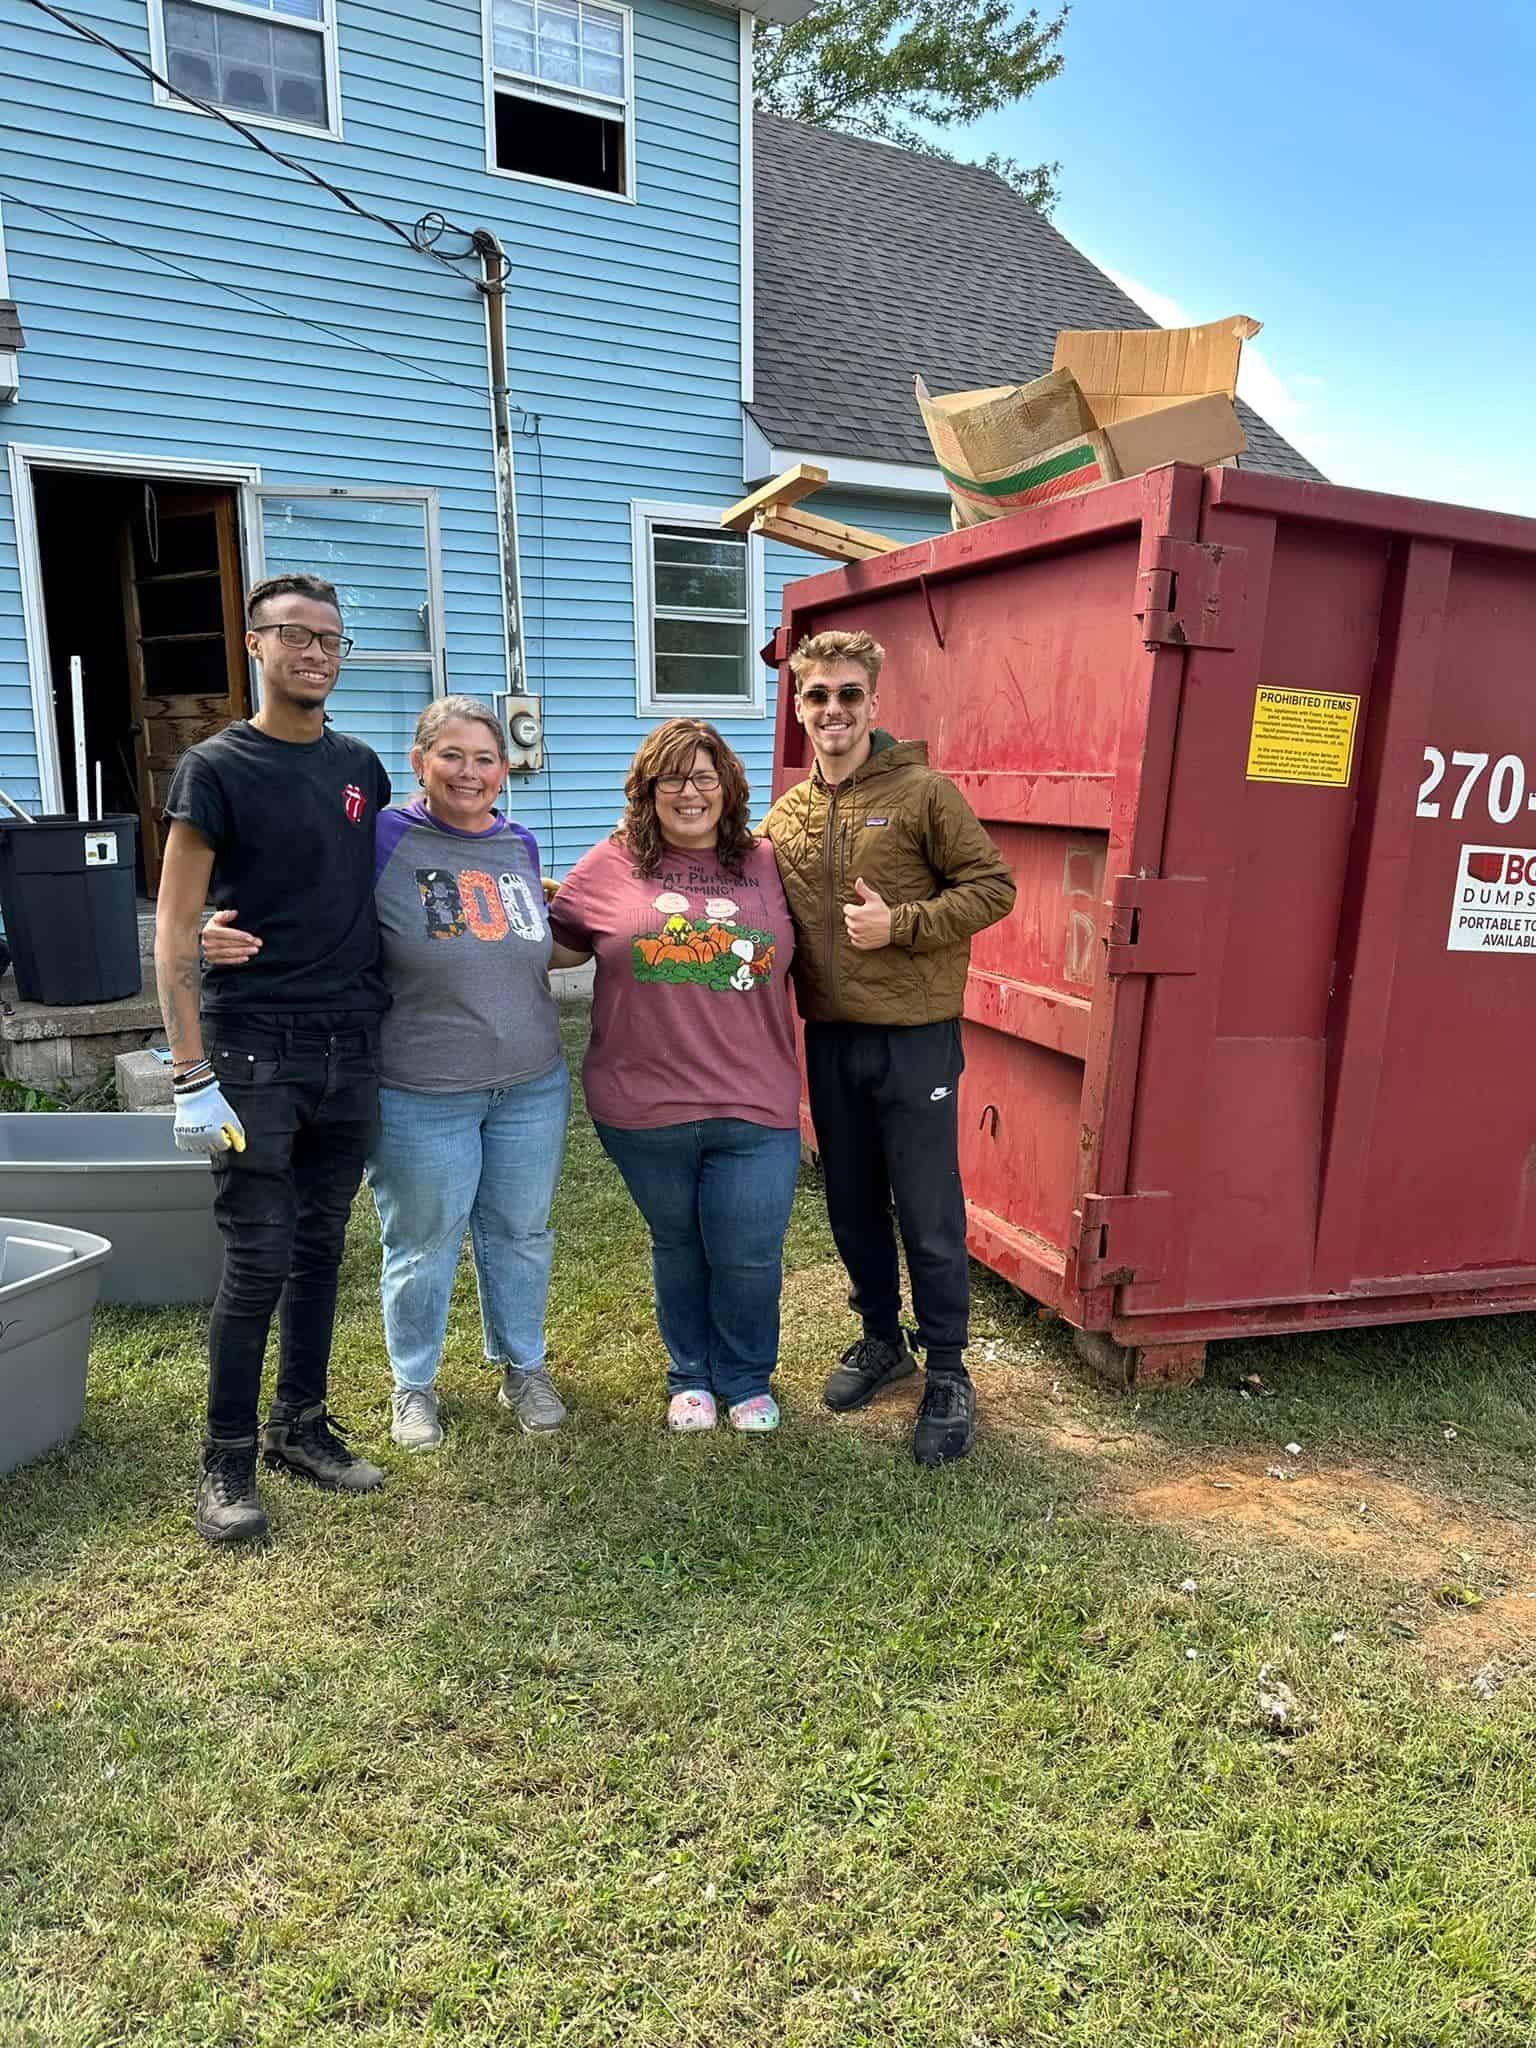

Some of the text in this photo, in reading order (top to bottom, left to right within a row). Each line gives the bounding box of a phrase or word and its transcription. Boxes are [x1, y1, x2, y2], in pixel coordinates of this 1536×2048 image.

[1260, 691, 1353, 712] PROHIBITED ITEMS
[415, 868, 547, 943] BOO
[1463, 888, 1536, 907] DUMPS
[1459, 916, 1521, 931] PORTABLE
